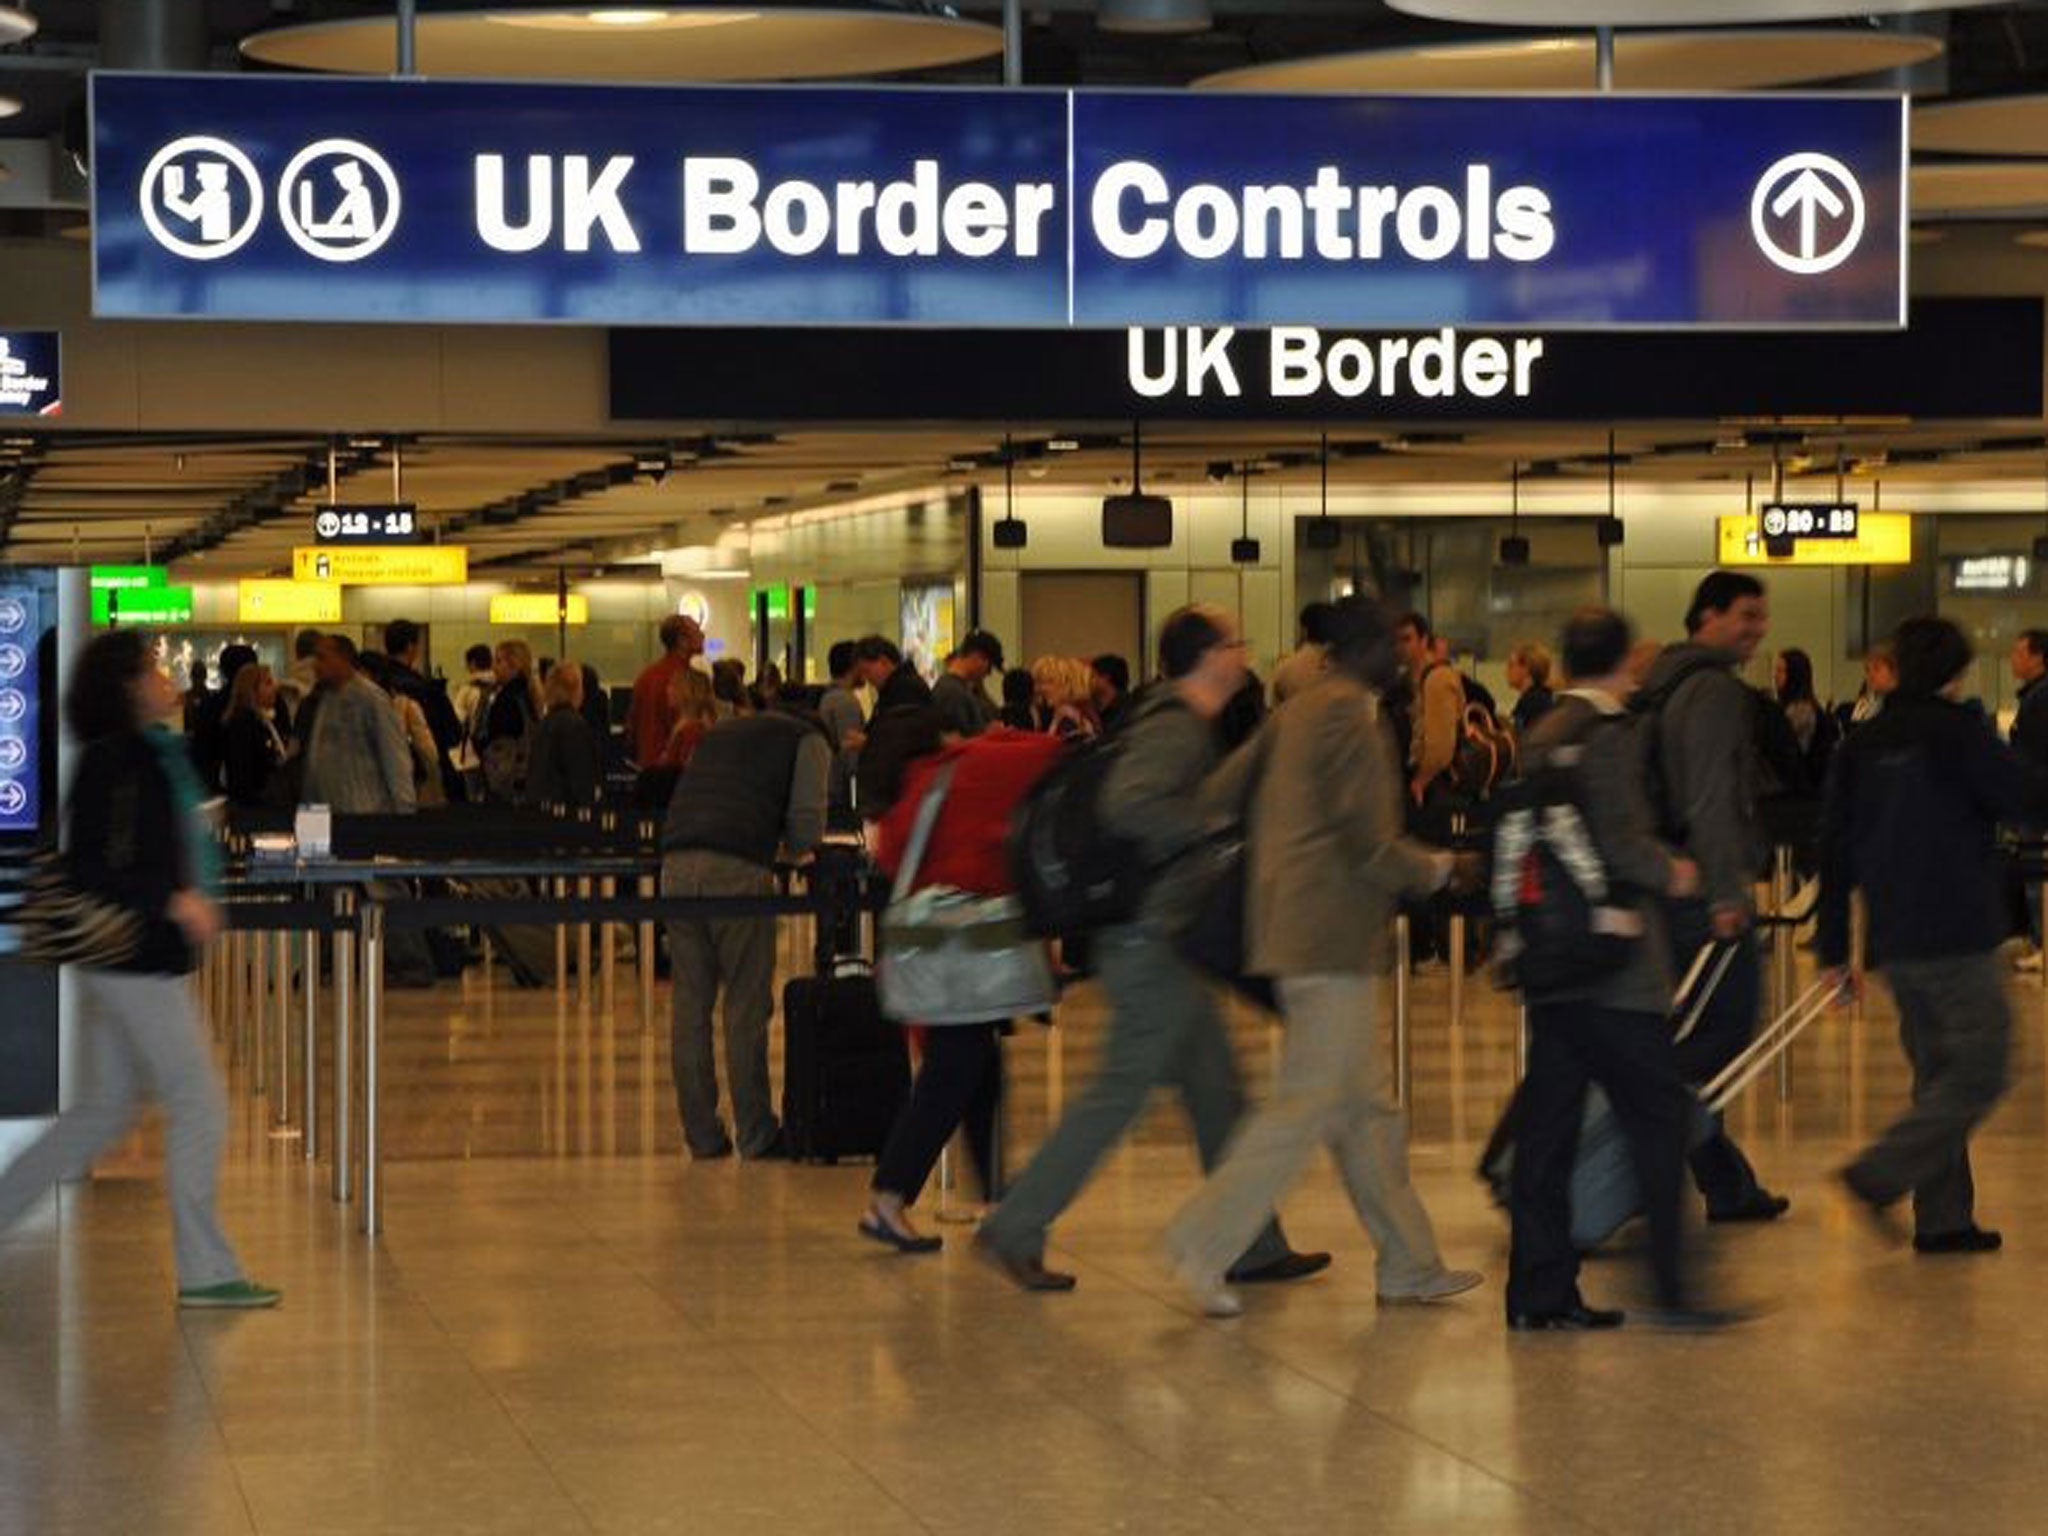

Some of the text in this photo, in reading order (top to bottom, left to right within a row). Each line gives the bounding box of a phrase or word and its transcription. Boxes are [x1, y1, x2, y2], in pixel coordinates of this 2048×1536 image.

[475, 153, 1556, 261] UK Border Controls
[1128, 327, 1544, 397] UK Border
